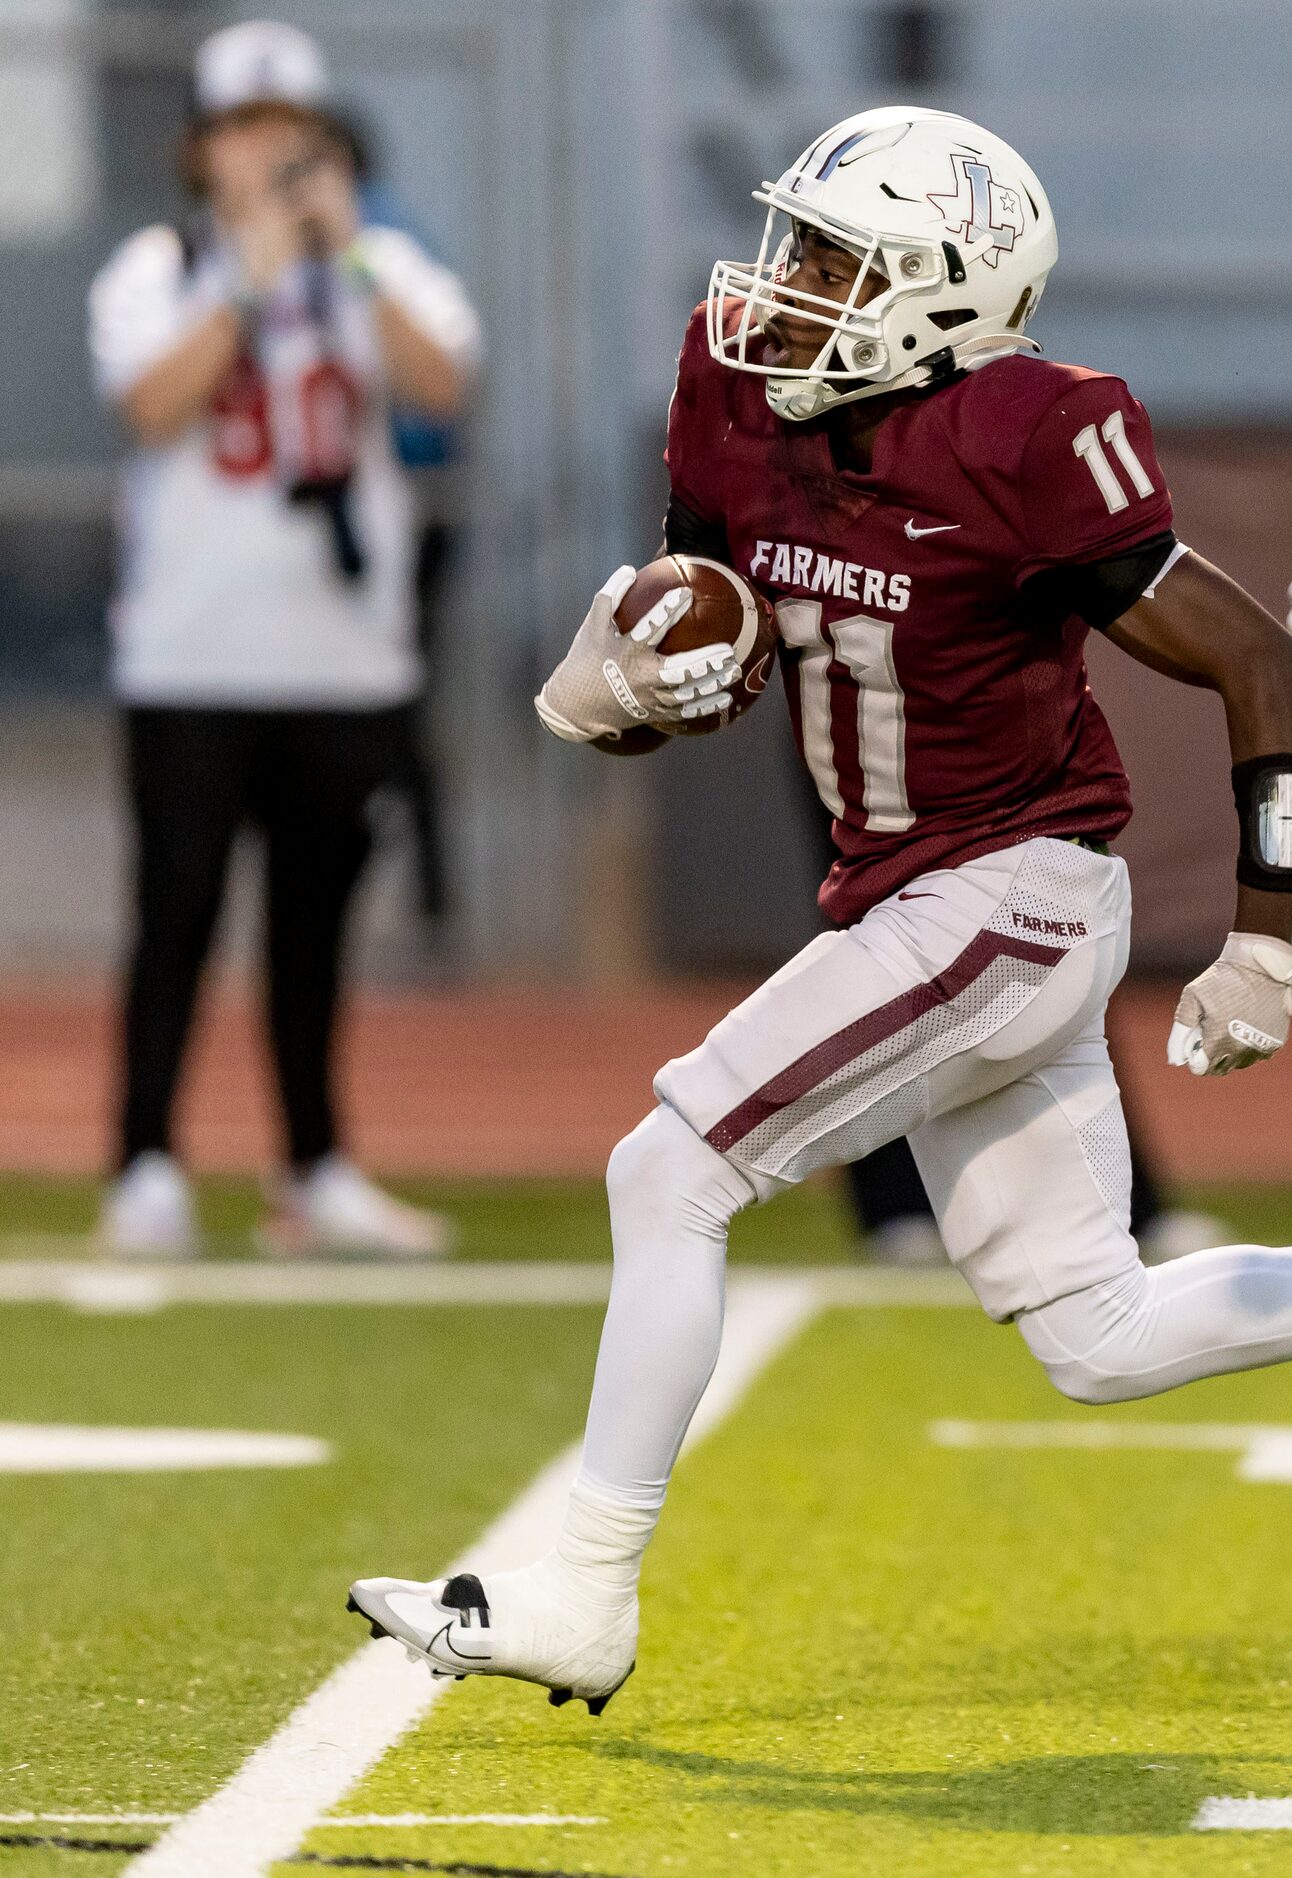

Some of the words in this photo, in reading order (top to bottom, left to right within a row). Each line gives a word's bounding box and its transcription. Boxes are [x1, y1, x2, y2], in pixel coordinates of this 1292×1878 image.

[1072, 409, 1156, 515] 11
[750, 540, 912, 612] FARMERS
[774, 597, 917, 832] 11
[1012, 911, 1088, 937] FARMERS
